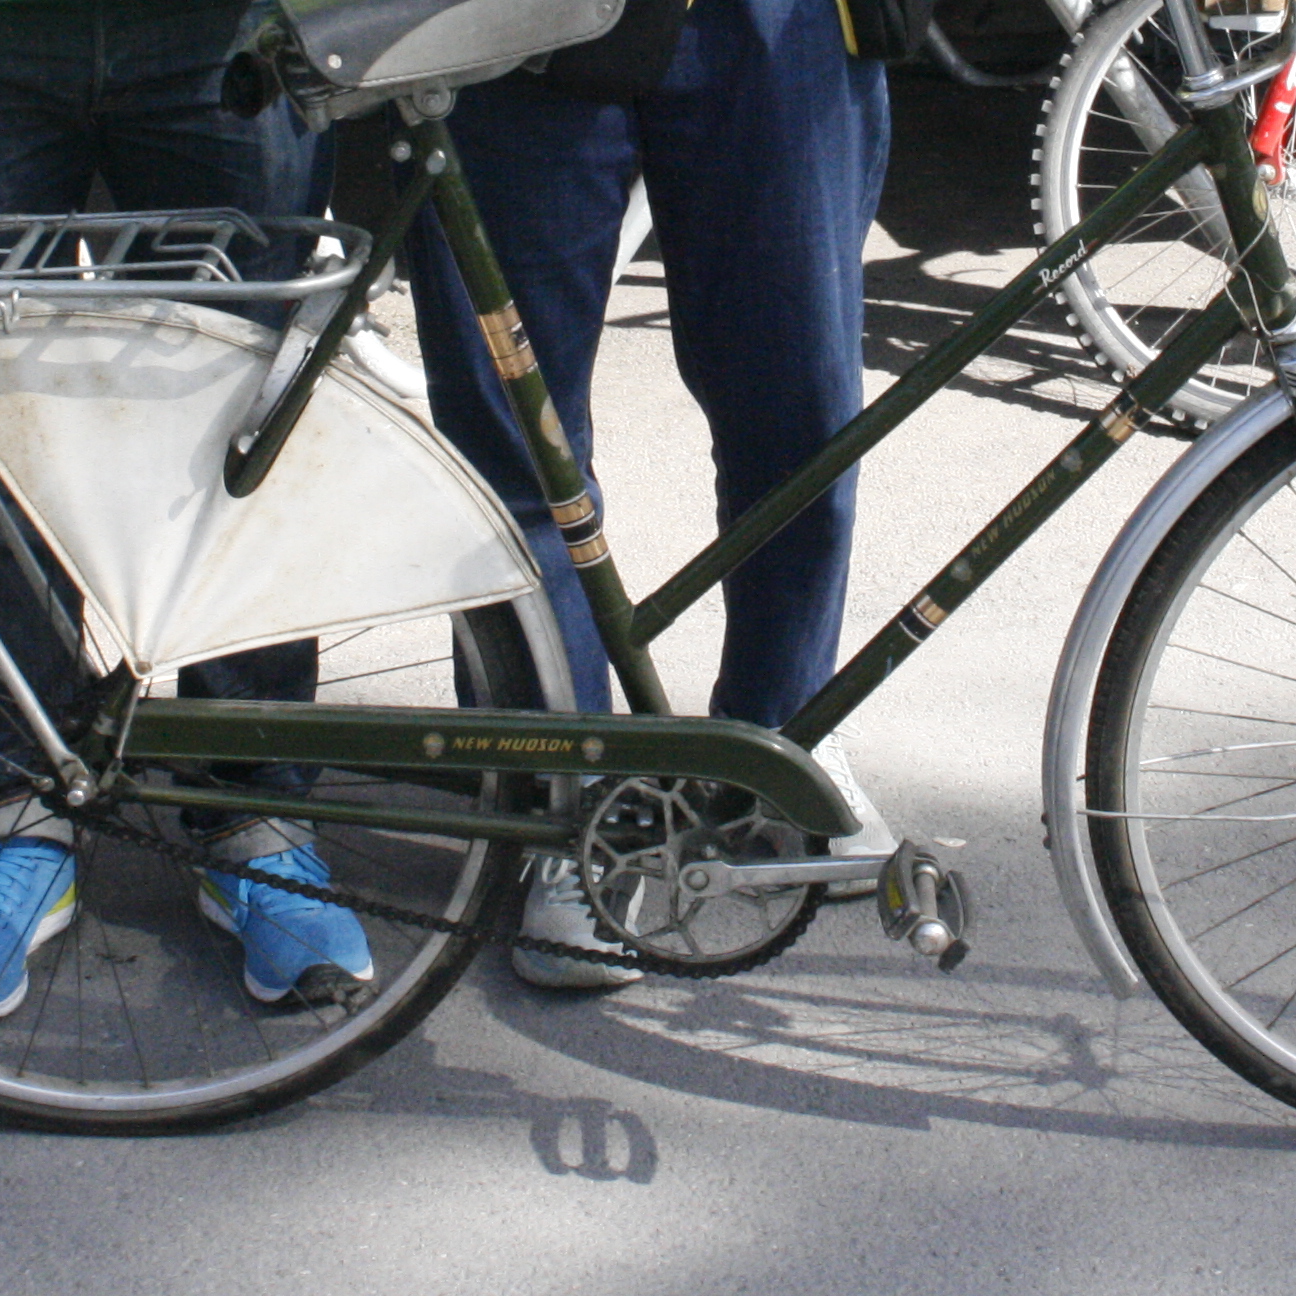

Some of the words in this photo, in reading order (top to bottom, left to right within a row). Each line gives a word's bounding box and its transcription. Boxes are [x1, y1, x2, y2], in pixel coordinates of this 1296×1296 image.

[1038, 238, 1089, 288] Record
[452, 735, 494, 751] NEW
[496, 736, 575, 753] HUDSON
